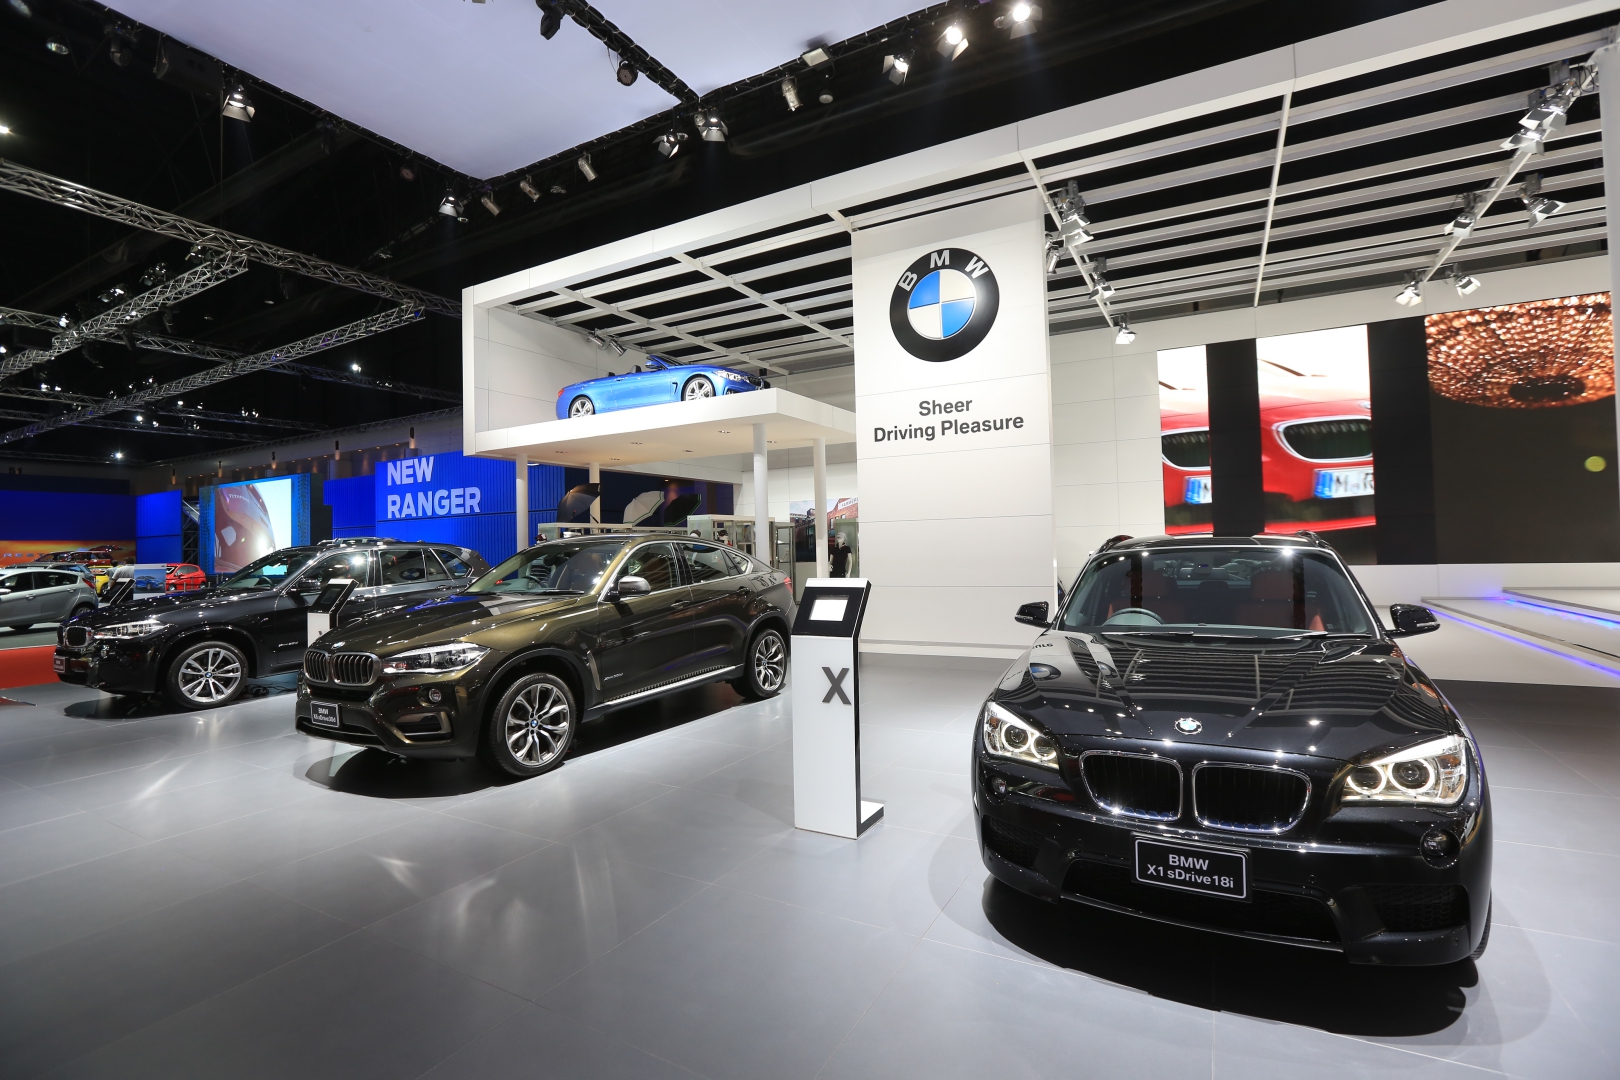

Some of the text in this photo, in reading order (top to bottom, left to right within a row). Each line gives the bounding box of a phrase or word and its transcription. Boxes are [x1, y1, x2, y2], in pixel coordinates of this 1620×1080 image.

[898, 249, 989, 292] BMW
[918, 399, 973, 417] Sheer
[874, 416, 1024, 443] Driving Pleasure
[387, 455, 435, 486] NEW
[387, 486, 481, 519] RANGER
[821, 666, 852, 705] X
[1146, 863, 1234, 889] X1 sDrive18i
[1168, 853, 1209, 871] BMW
